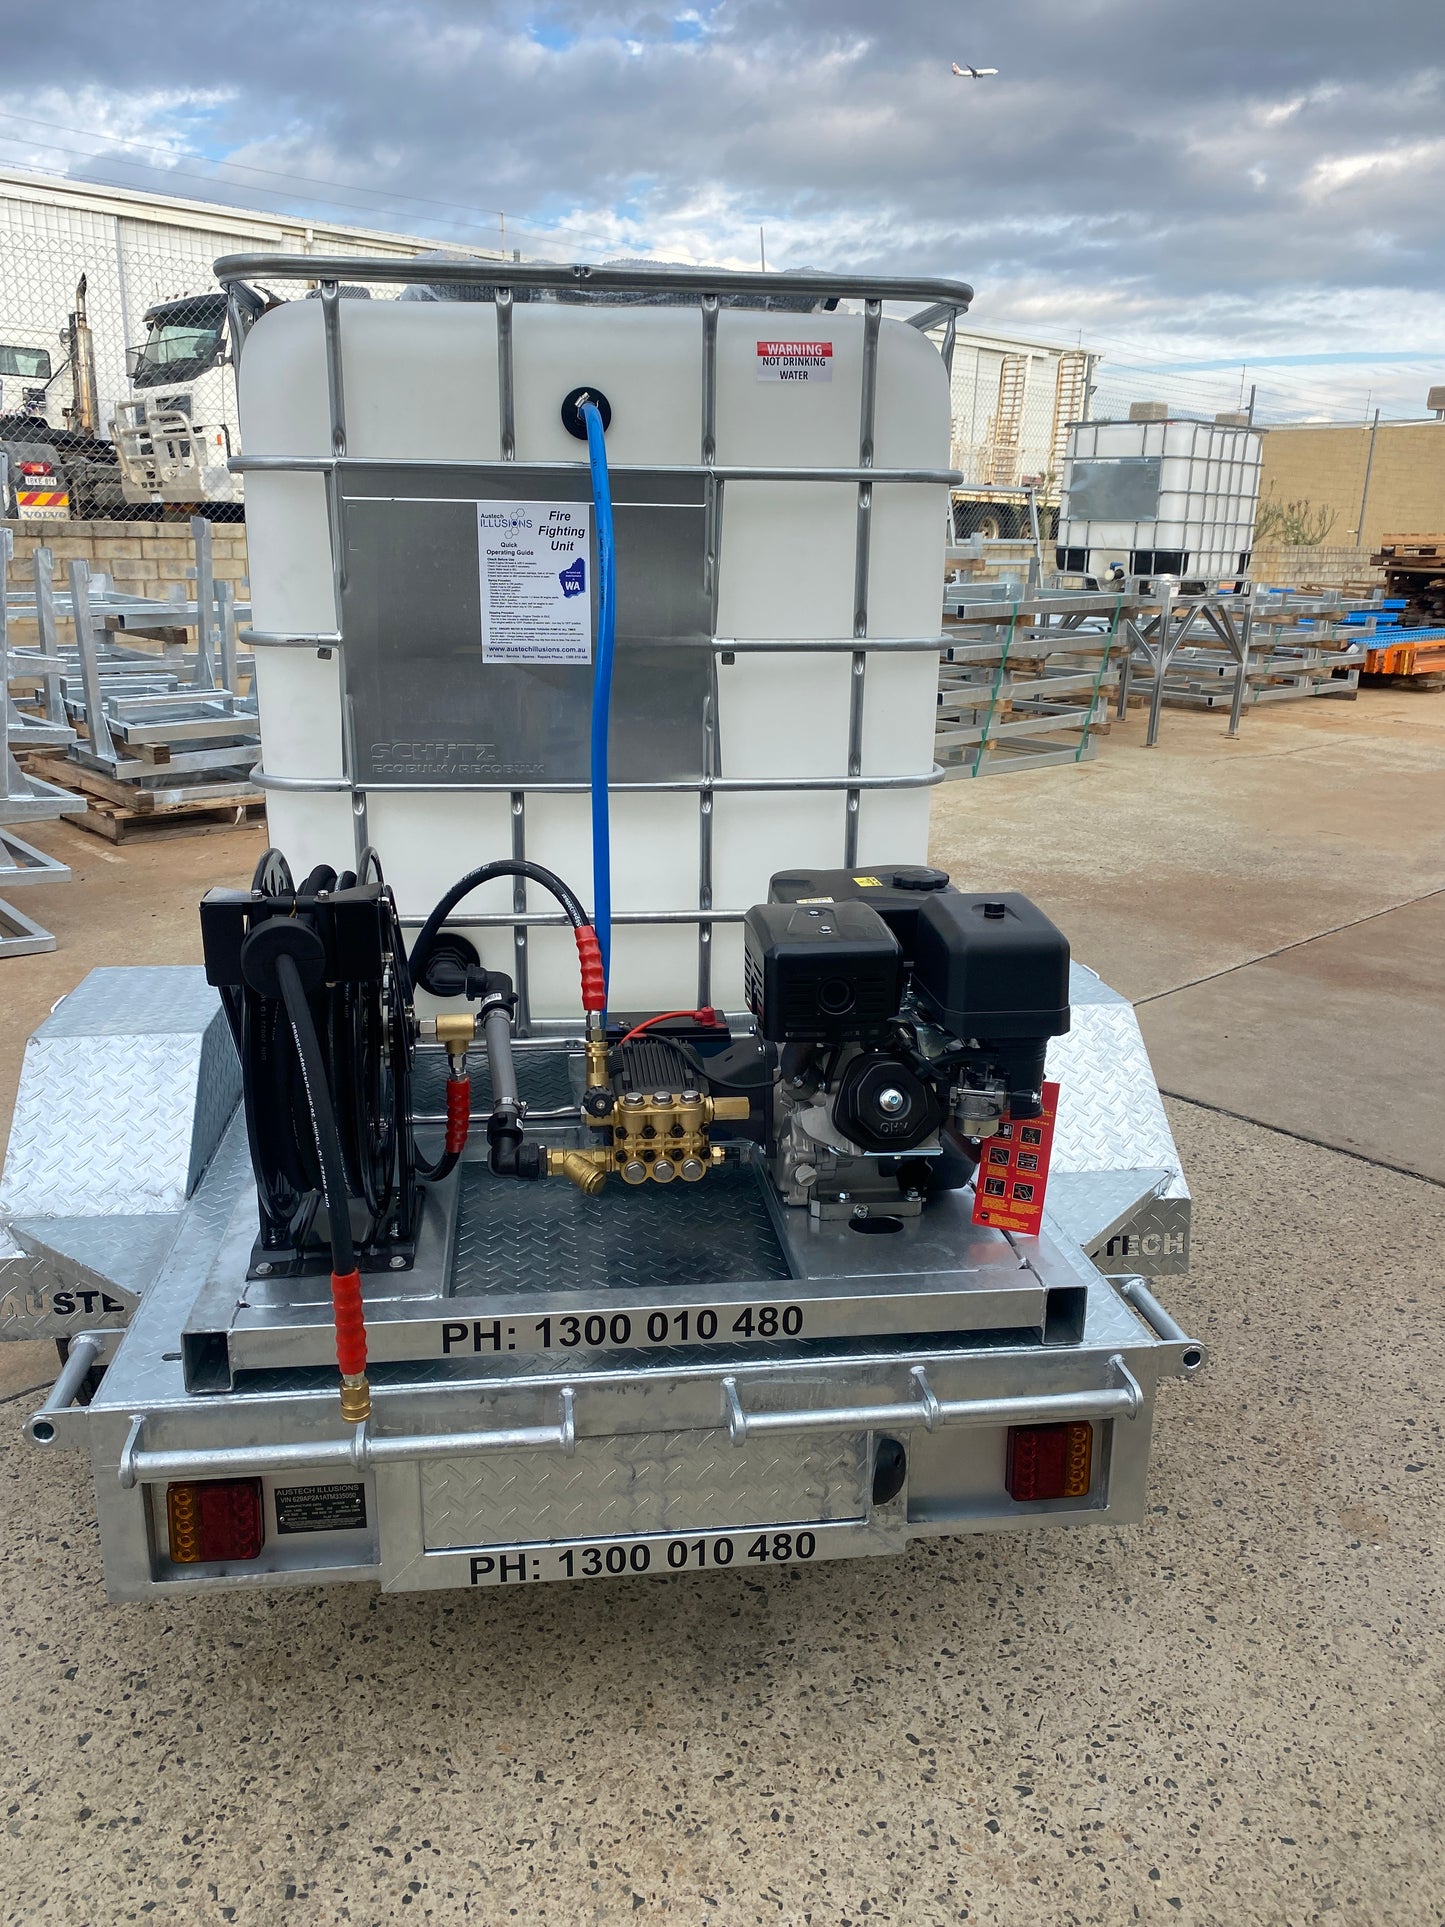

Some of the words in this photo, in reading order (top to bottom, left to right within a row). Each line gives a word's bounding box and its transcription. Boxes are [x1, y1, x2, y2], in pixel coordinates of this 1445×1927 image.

[767, 344, 822, 355] WARNING
[762, 357, 780, 366] NOT
[783, 357, 826, 366] DRINKING
[780, 370, 808, 380] WATER
[23, 511, 67, 519] VOLVO
[549, 511, 571, 521] Fire
[538, 525, 586, 538] Fighting
[551, 541, 574, 551] Unit
[565, 581, 580, 591] WA
[442, 1321, 516, 1354] PH:
[534, 1313, 632, 1348] 1300
[646, 1309, 719, 1342] 010
[731, 1305, 804, 1338] 480
[276, 1487, 316, 1497] AUSTECH
[317, 1484, 360, 1493] ILLUSIONS
[280, 1496, 292, 1504] VIN
[469, 1553, 541, 1585] PH:
[557, 1543, 651, 1577] 1300
[666, 1537, 734, 1568] 010
[747, 1531, 817, 1562] 480
